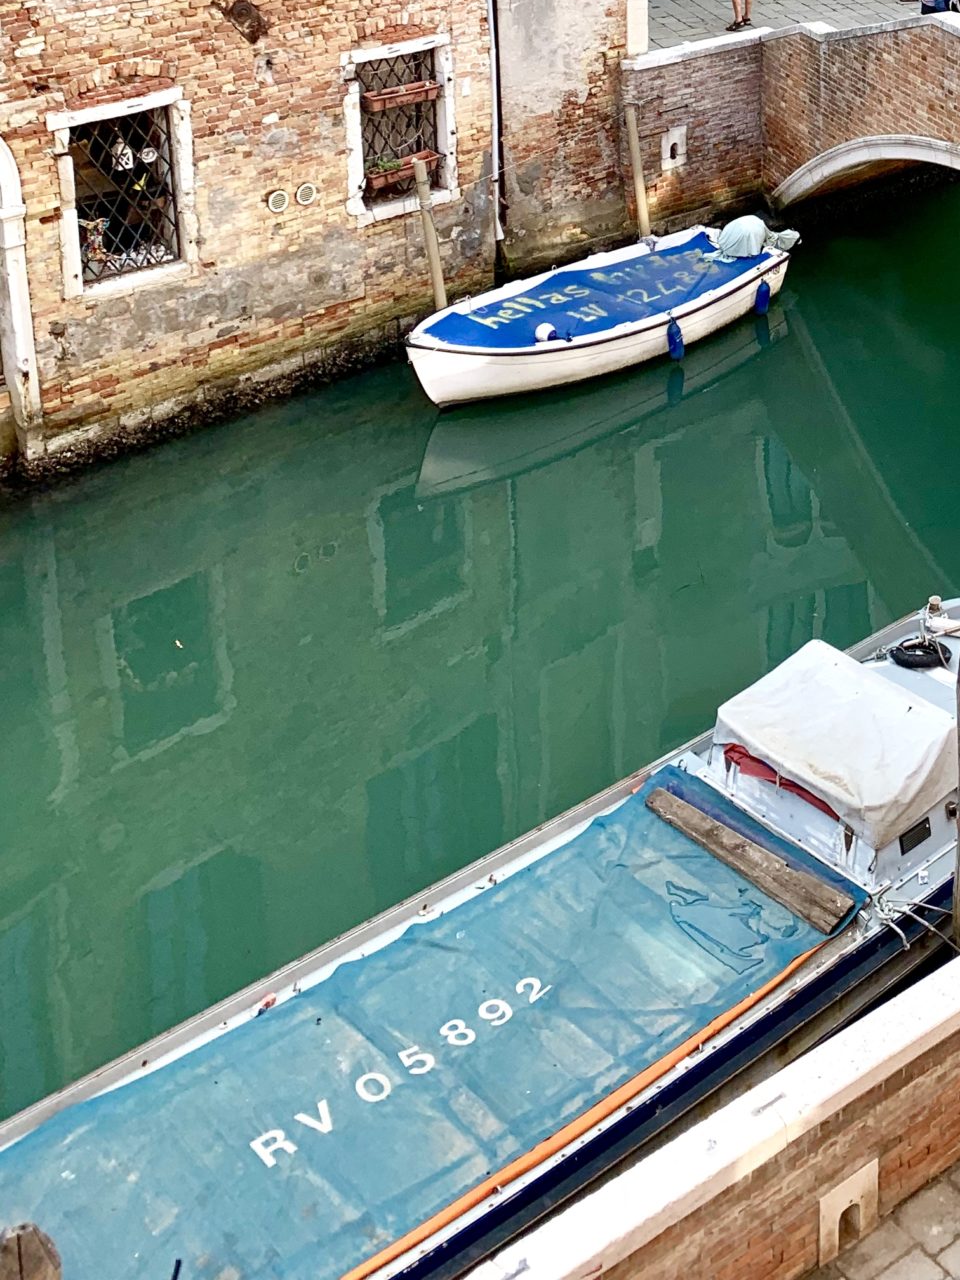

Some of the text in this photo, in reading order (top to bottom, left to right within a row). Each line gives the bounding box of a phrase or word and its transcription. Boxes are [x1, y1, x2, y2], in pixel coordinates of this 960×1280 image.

[467, 285, 590, 330] hellas
[249, 976, 553, 1169] RV 05892
